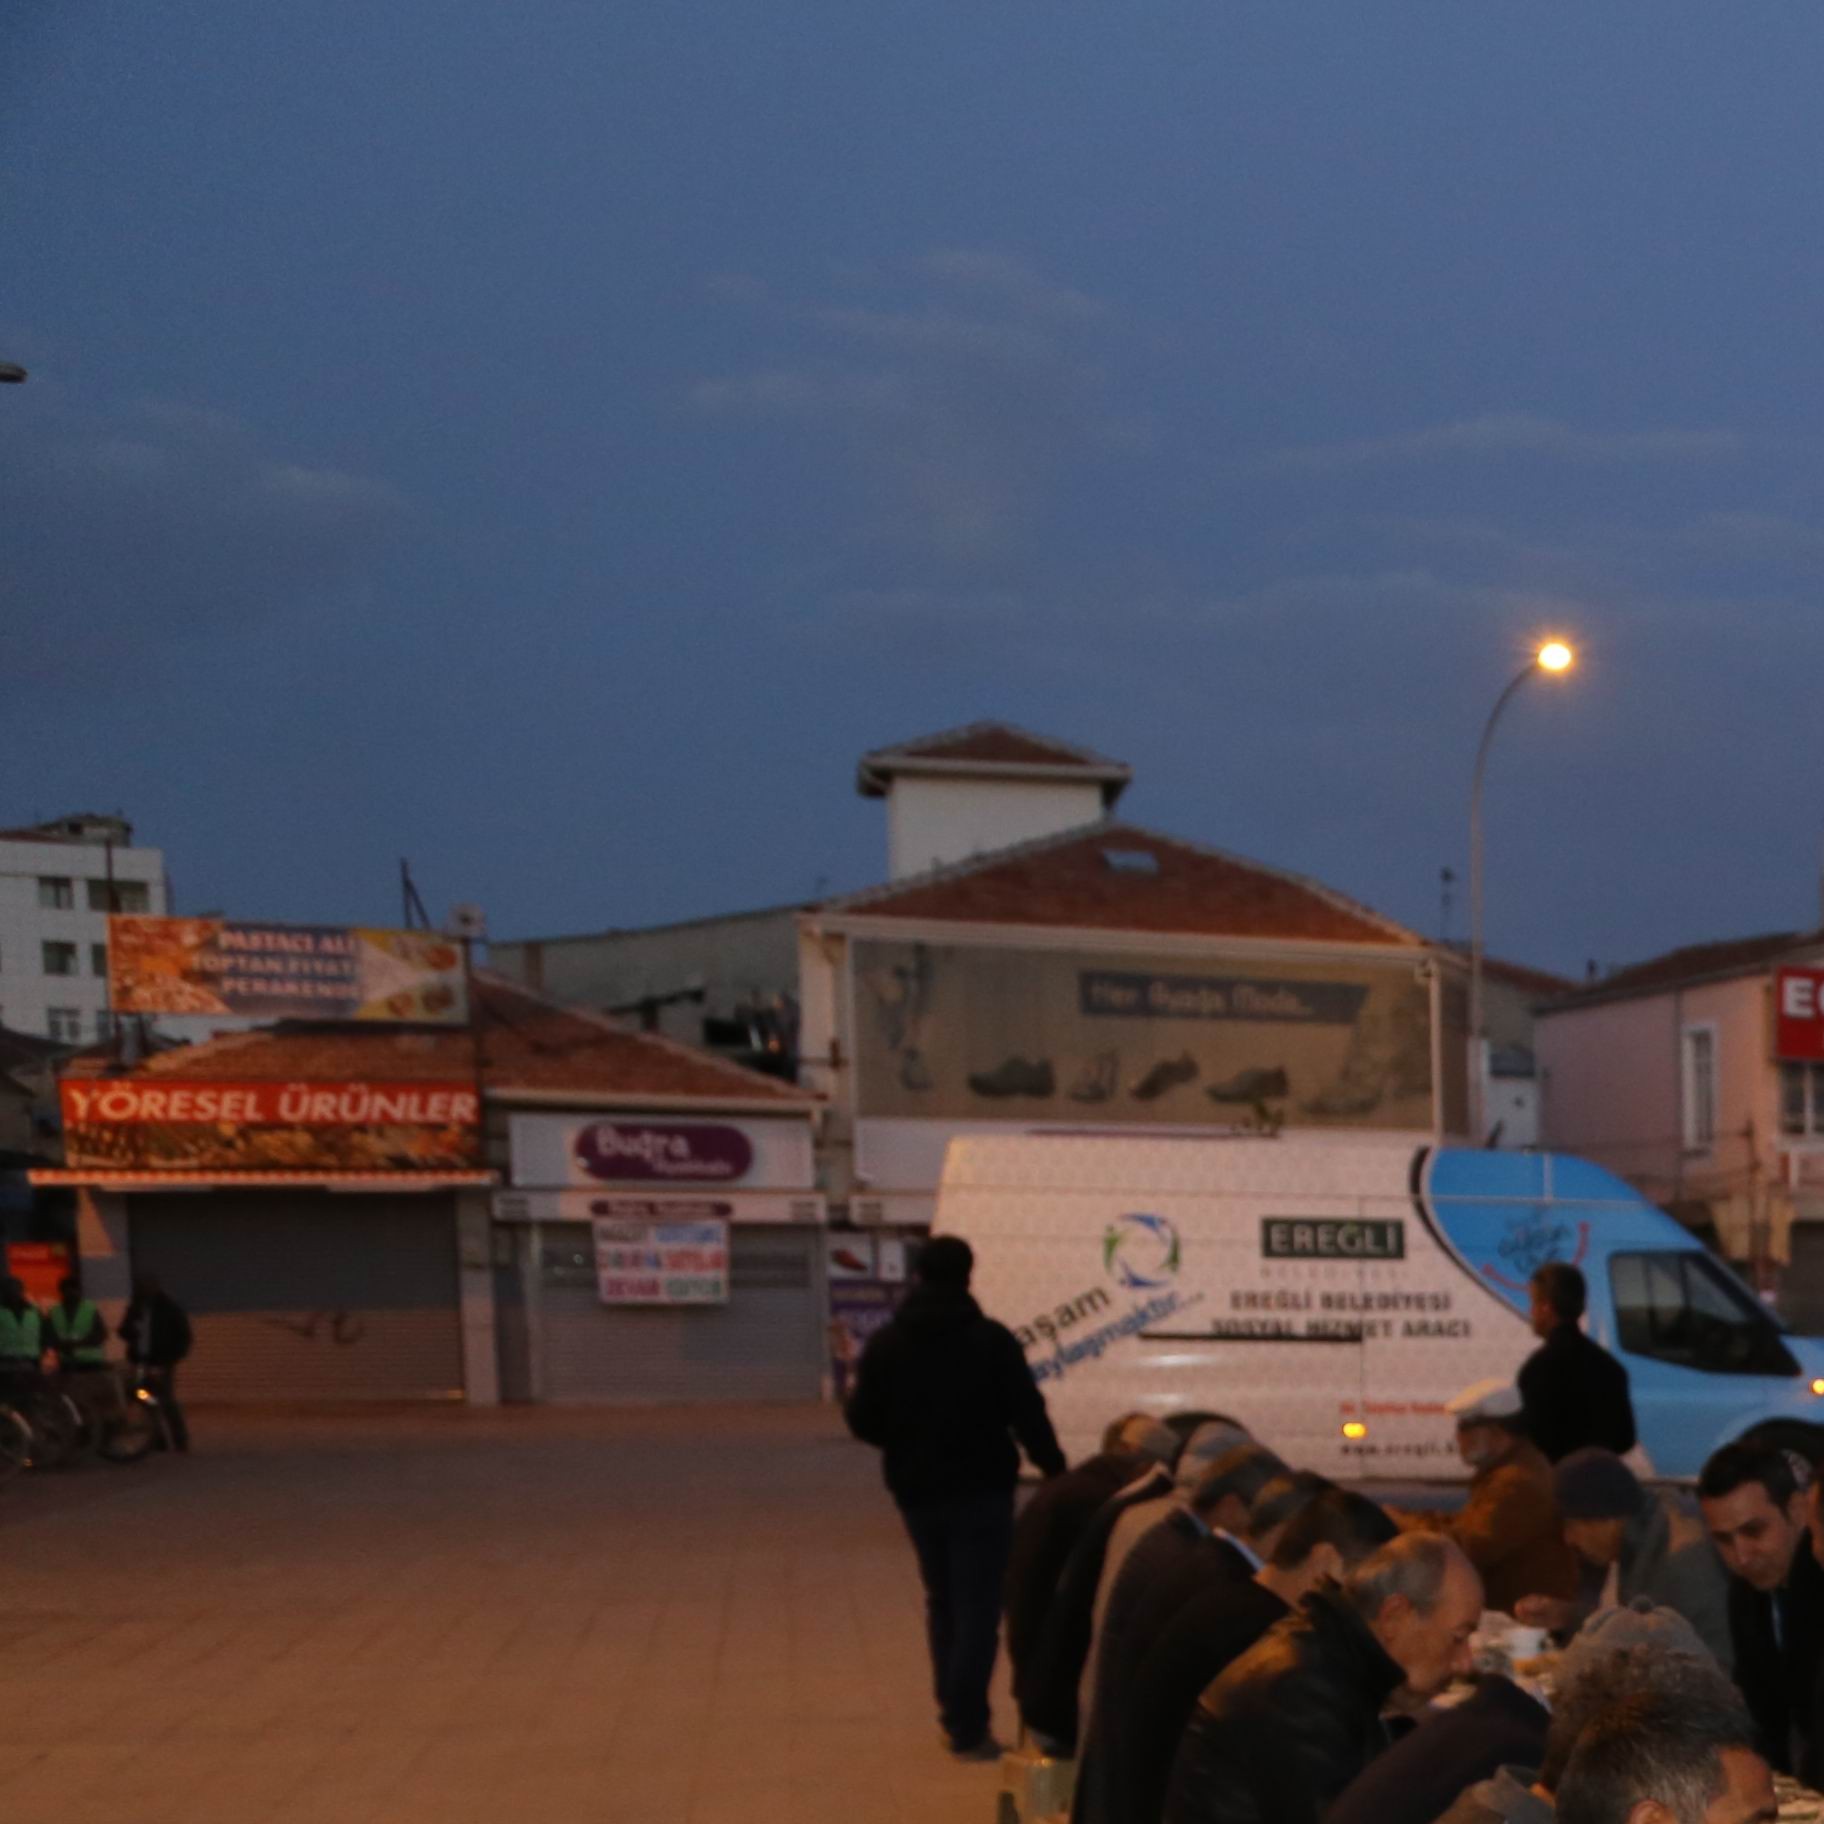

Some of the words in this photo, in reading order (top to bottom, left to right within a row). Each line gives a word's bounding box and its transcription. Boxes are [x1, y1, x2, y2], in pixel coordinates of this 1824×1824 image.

[68, 1081, 265, 1123] YÖRESEL
[277, 1081, 479, 1124] ÜRÜNLER
[1270, 1223, 1398, 1255] EREĞLİ
